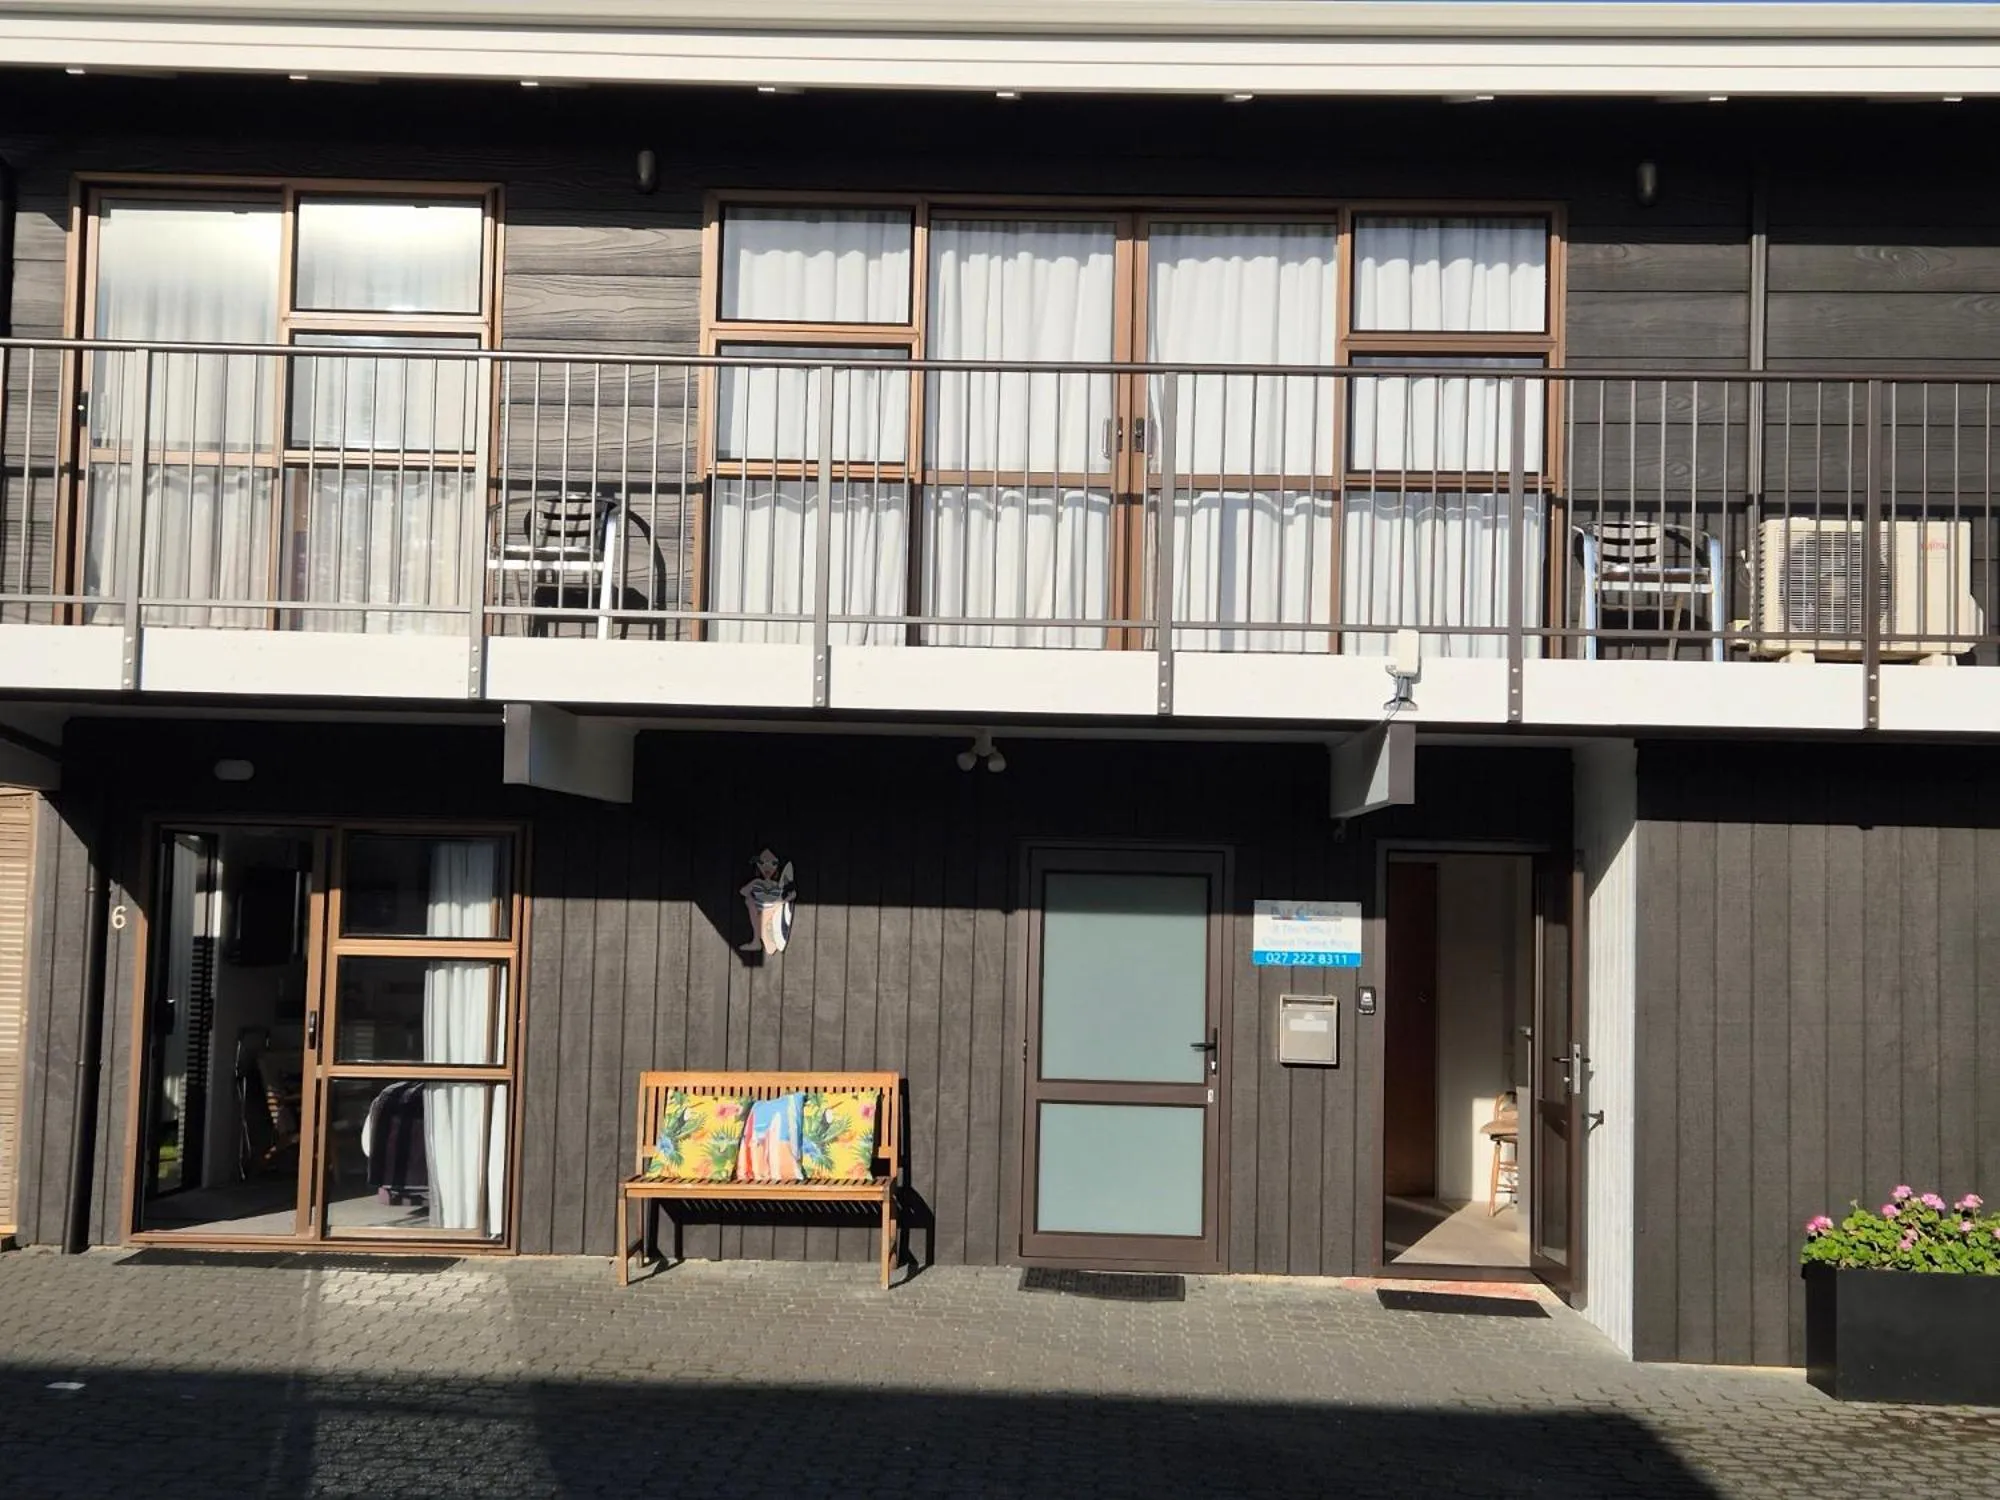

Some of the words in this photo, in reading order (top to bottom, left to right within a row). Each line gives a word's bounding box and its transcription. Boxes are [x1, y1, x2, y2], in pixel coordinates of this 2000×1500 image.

[112, 905, 127, 929] 6
[1265, 952, 1288, 963] 027
[1292, 953, 1316, 964] 222
[1318, 954, 1348, 965] 8311
